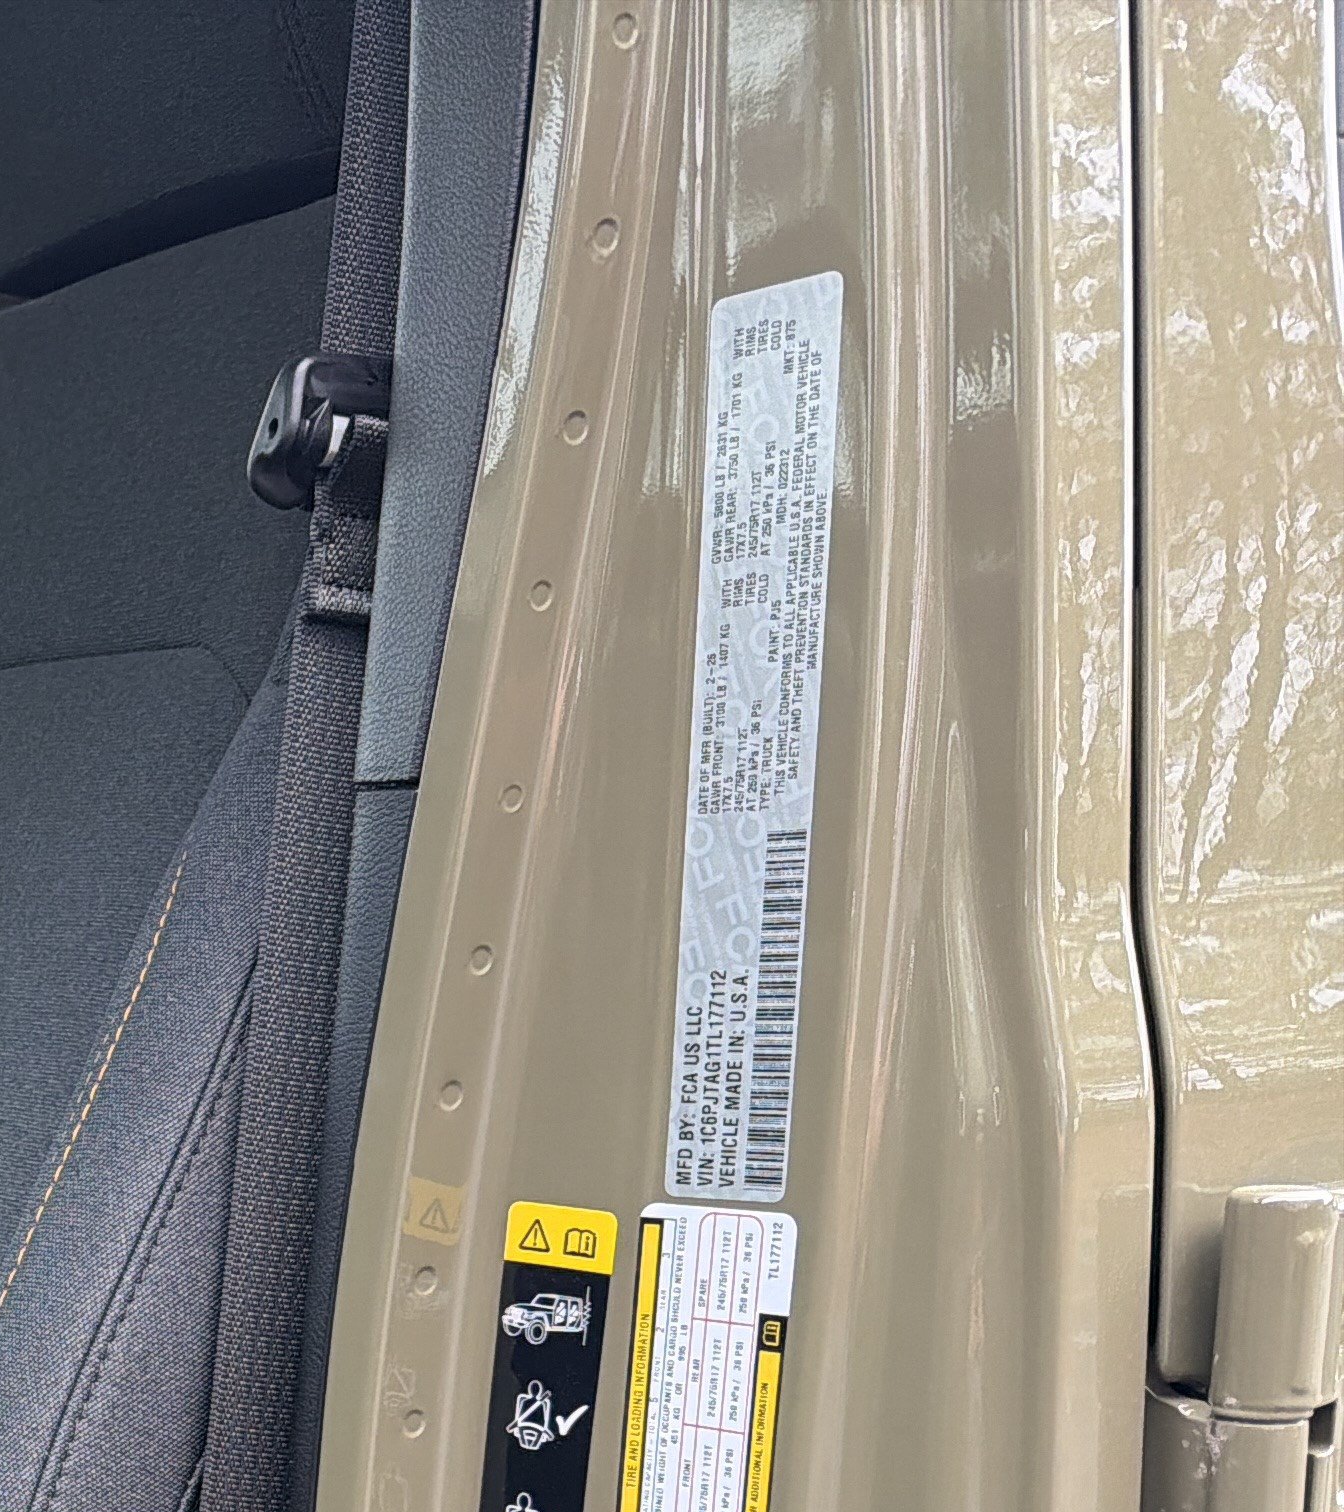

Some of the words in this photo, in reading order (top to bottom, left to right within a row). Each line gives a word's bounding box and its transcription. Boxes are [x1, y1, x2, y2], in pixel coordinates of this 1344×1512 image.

[732, 326, 744, 359] WITH
[757, 318, 768, 354] TIRES
[770, 319, 782, 351] COLD
[797, 338, 811, 389] VEHICLE
[811, 348, 824, 366] OF
[732, 371, 743, 388] KG
[809, 368, 822, 400] DATE
[731, 391, 742, 419] 1701
[794, 391, 808, 434] MOTOR
[807, 403, 820, 428] THE
[729, 435, 740, 449] LB
[736, 521, 747, 560] 17X7.5
[745, 325, 756, 357] RIMS
[806, 431, 818, 449] ON
[727, 453, 739, 480] 3750
[791, 437, 805, 491] FEDERAL
[803, 451, 817, 495] EFFECT
[750, 469, 761, 496] 112T
[725, 487, 737, 523] REAR:
[802, 499, 814, 512] IN
[748, 499, 760, 558] 245/75R17
[761, 516, 772, 537] 250
[724, 527, 735, 562] GAWR
[760, 541, 771, 556] AT
[799, 516, 813, 587] STANDARDS
[812, 534, 825, 578] SHOWN
[785, 534, 800, 605] APPLICABLE
[720, 578, 732, 608] WITH
[757, 572, 769, 603] COLD
[770, 599, 781, 620] PJ5
[784, 608, 795, 630] ALL
[806, 582, 822, 669] MANUFACTURE
[767, 624, 780, 662] PAINT:
[782, 632, 793, 648] TO
[794, 590, 809, 663] PREVENTION
[722, 775, 733, 813] 17X7.5
[733, 577, 744, 607] RIMS
[734, 756, 746, 812] 245/75R17
[745, 571, 756, 605] TIRES
[778, 652, 792, 715] CONFORMS
[791, 668, 804, 703] THEFT
[790, 708, 802, 732] AND
[700, 740, 711, 764] MFR
[712, 734, 724, 775] FRONT:
[761, 736, 773, 772] TRUCK
[776, 718, 788, 765] VEHICLE
[787, 736, 800, 779] SAFETY
[699, 767, 709, 782] OF
[774, 769, 785, 795] THIS
[697, 784, 708, 814] DATE
[710, 780, 721, 813] GAWR
[758, 777, 771, 810] TYPE:
[729, 968, 748, 1021] U.S.A.
[685, 1006, 702, 1035] LLC
[683, 1042, 700, 1065] US
[699, 970, 726, 1144] 1C6PJTAG1TL177112
[727, 1030, 745, 1052] IN:
[681, 1073, 698, 1103] FCA
[724, 1060, 743, 1109] MADE
[678, 1113, 695, 1140] BY:
[675, 1148, 693, 1185] MFD
[718, 1117, 738, 1187] VEHICLE
[696, 1152, 715, 1186] VIN:
[767, 1221, 783, 1279] TL177112
[698, 1278, 707, 1307] SPARE
[634, 1312, 649, 1386] INFORMATION
[630, 1389, 644, 1436] LOADING
[755, 1382, 769, 1445] INFORMATION
[628, 1440, 639, 1461] AND
[626, 1463, 637, 1487] TIRE
[681, 1458, 691, 1487] FRONT
[749, 1448, 762, 1502] ADDITIONAL
